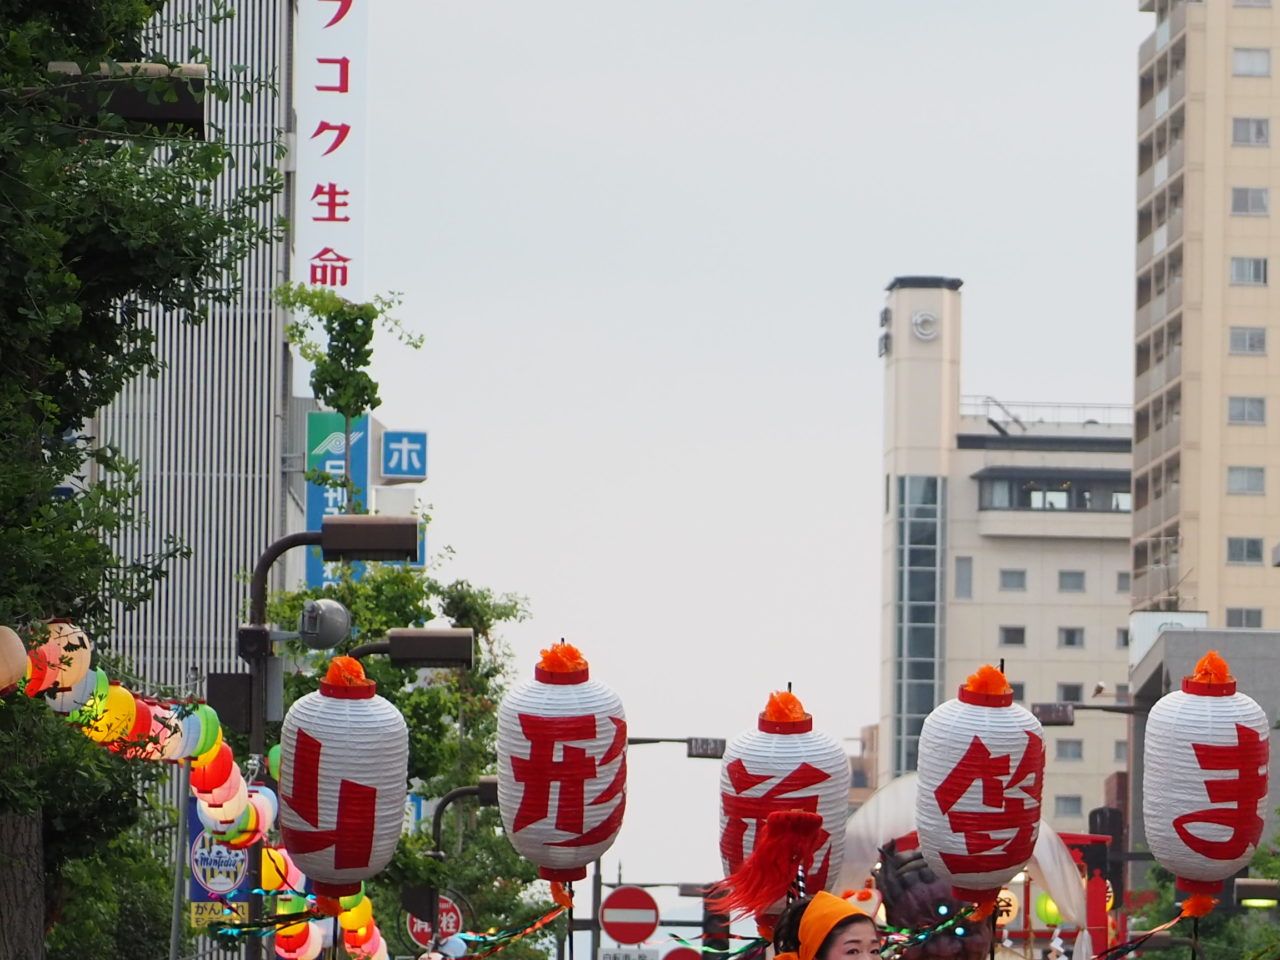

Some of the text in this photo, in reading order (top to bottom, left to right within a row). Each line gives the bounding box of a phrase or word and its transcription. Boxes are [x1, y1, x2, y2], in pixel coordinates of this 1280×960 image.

[388, 437, 422, 471] ホ
[509, 713, 628, 848] 形
[934, 729, 1047, 875] 笠
[1171, 723, 1271, 861] ま
